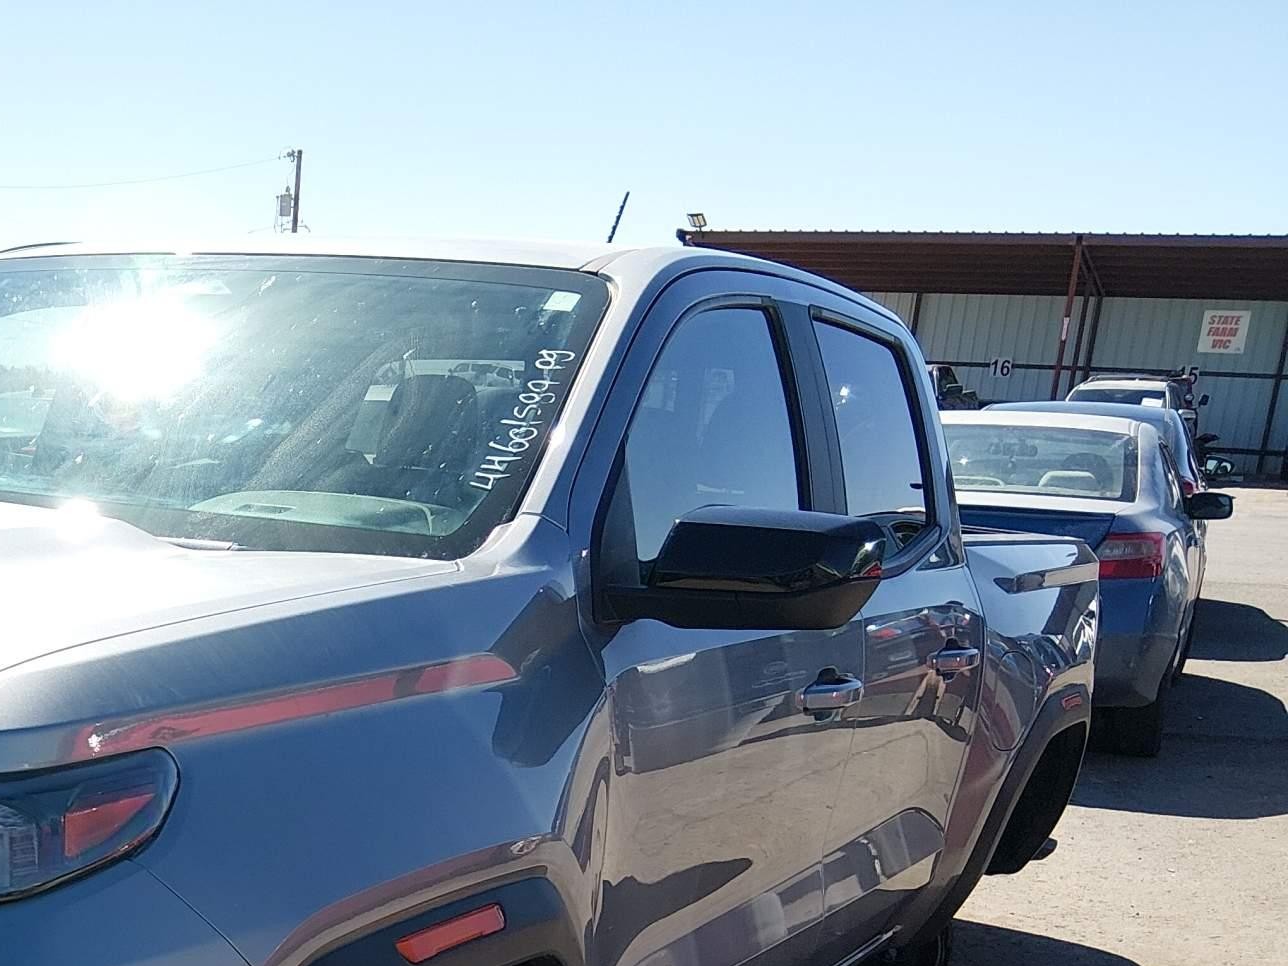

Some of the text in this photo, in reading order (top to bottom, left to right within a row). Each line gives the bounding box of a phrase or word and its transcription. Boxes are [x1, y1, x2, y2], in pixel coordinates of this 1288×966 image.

[1208, 315, 1242, 325] STATE
[1207, 327, 1239, 337] FARM
[991, 360, 1010, 376] 16
